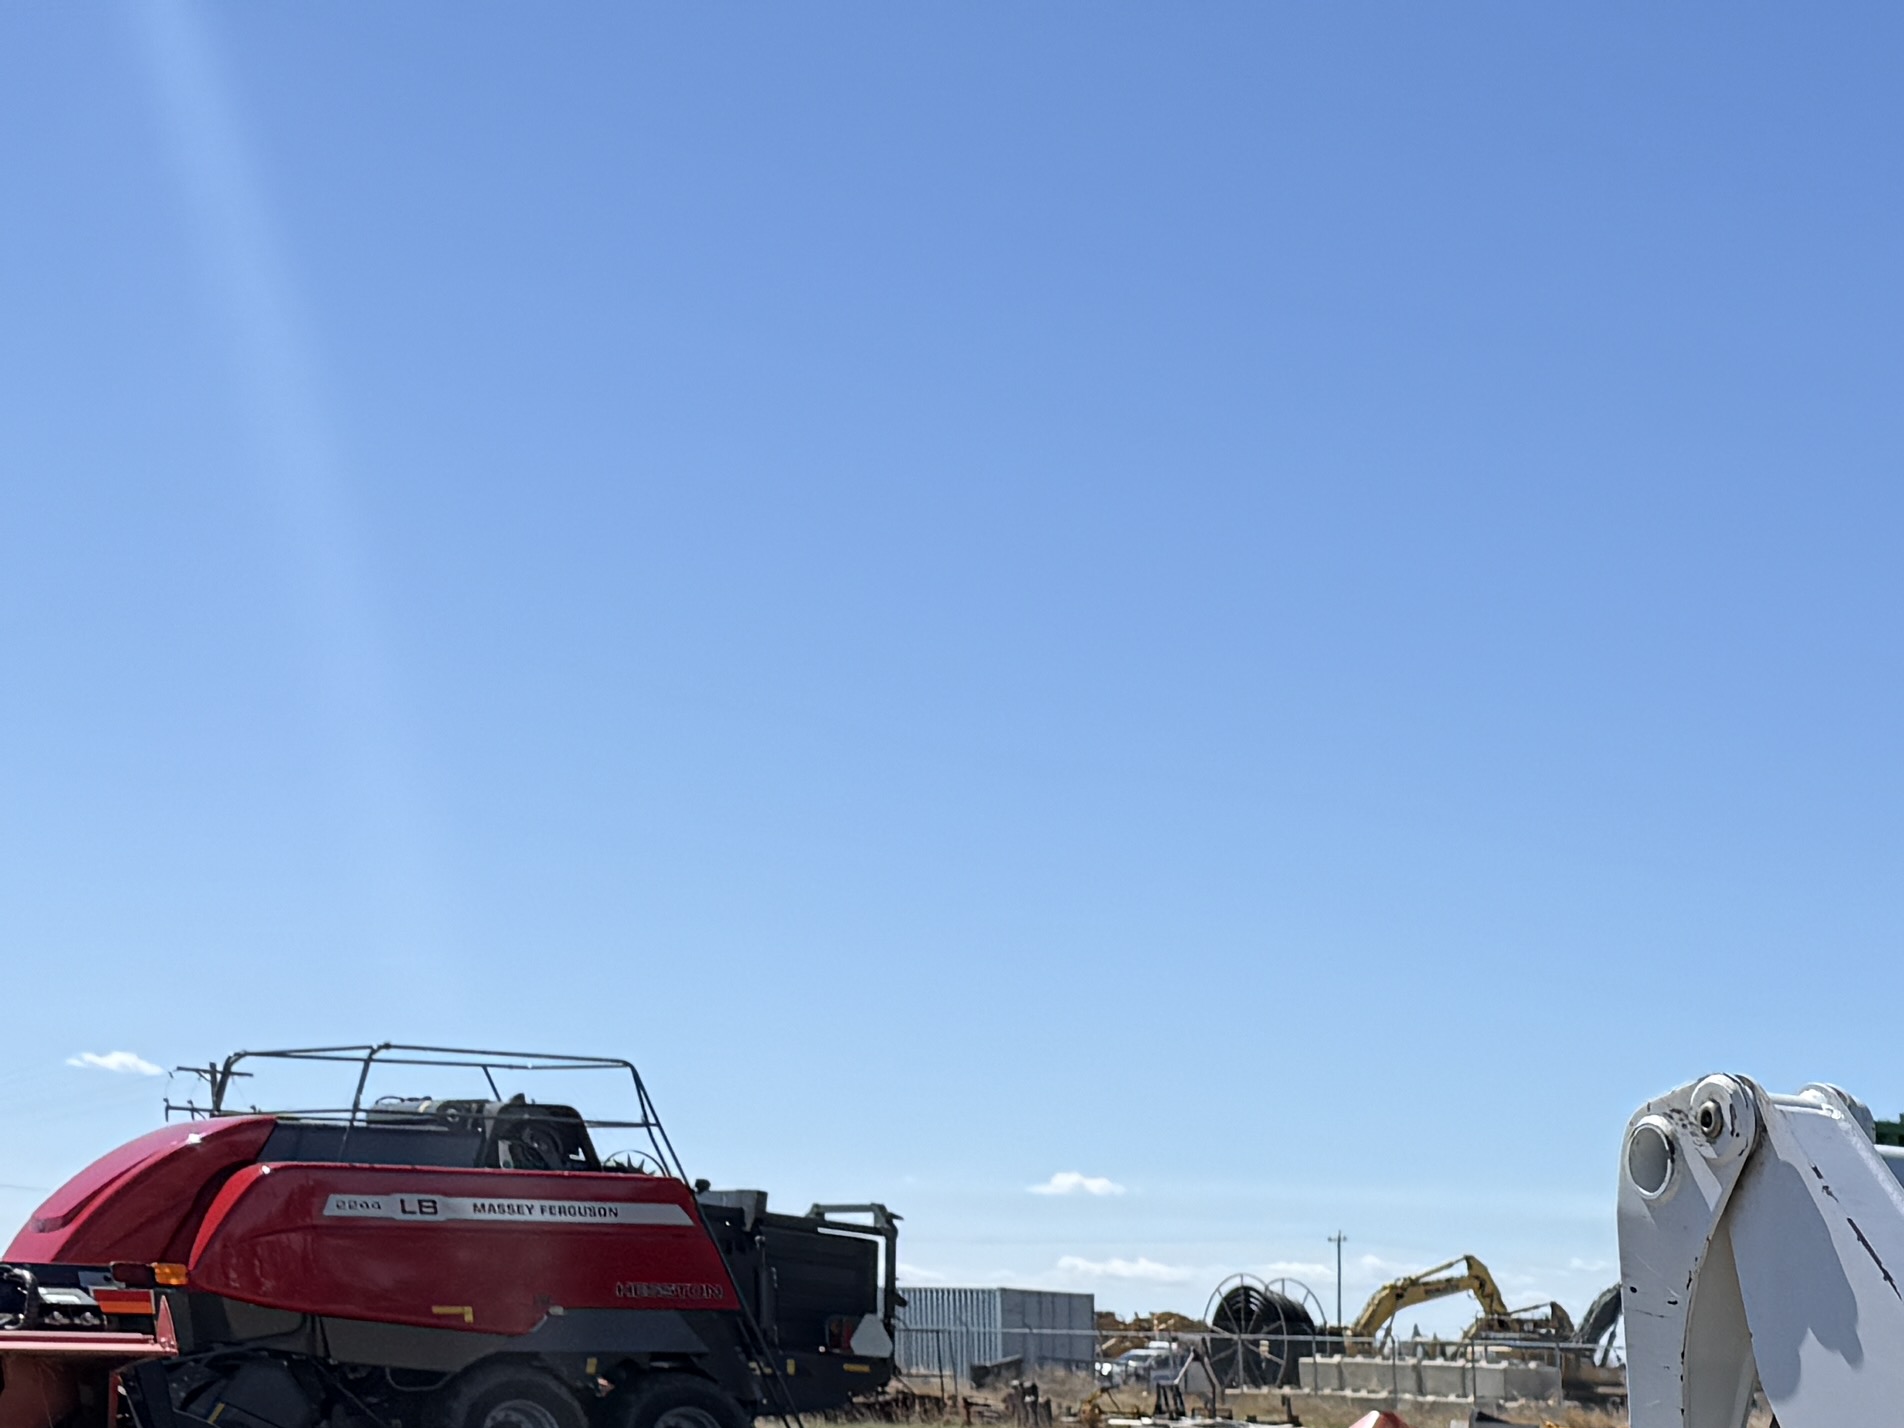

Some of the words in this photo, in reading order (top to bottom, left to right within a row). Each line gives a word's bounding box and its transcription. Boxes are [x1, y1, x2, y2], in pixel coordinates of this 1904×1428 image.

[399, 1198, 439, 1216] LB
[472, 1202, 535, 1216] MASSEY
[540, 1203, 620, 1218] FERGUSON
